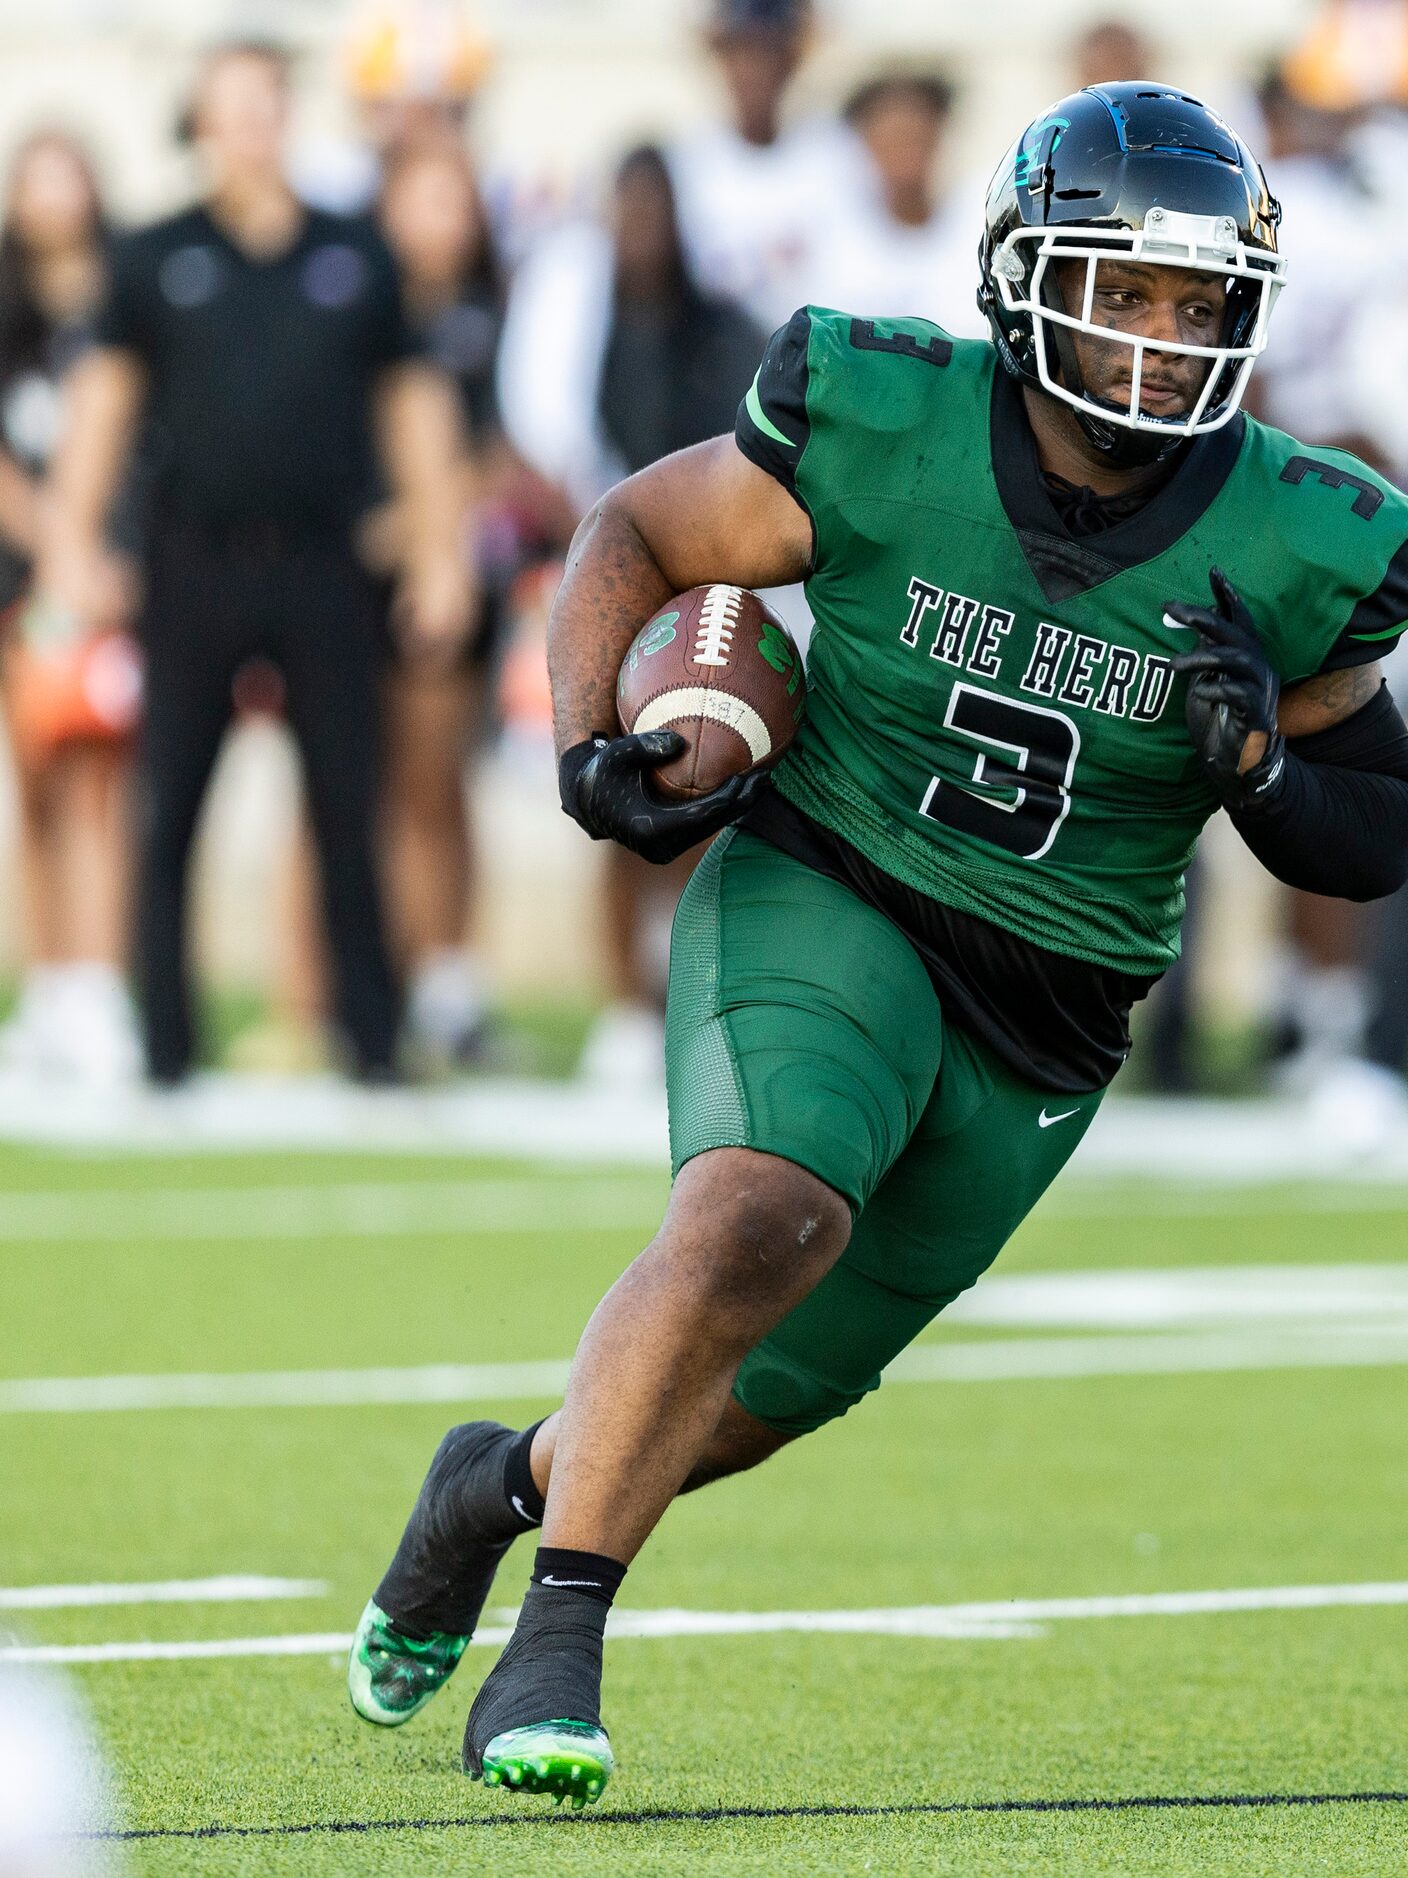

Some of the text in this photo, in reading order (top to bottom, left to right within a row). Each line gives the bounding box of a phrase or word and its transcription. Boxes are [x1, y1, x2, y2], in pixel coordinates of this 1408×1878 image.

[849, 317, 954, 368] 3
[1278, 455, 1386, 521] 3
[899, 575, 1175, 723] THE HERD
[918, 680, 1081, 860] 3
